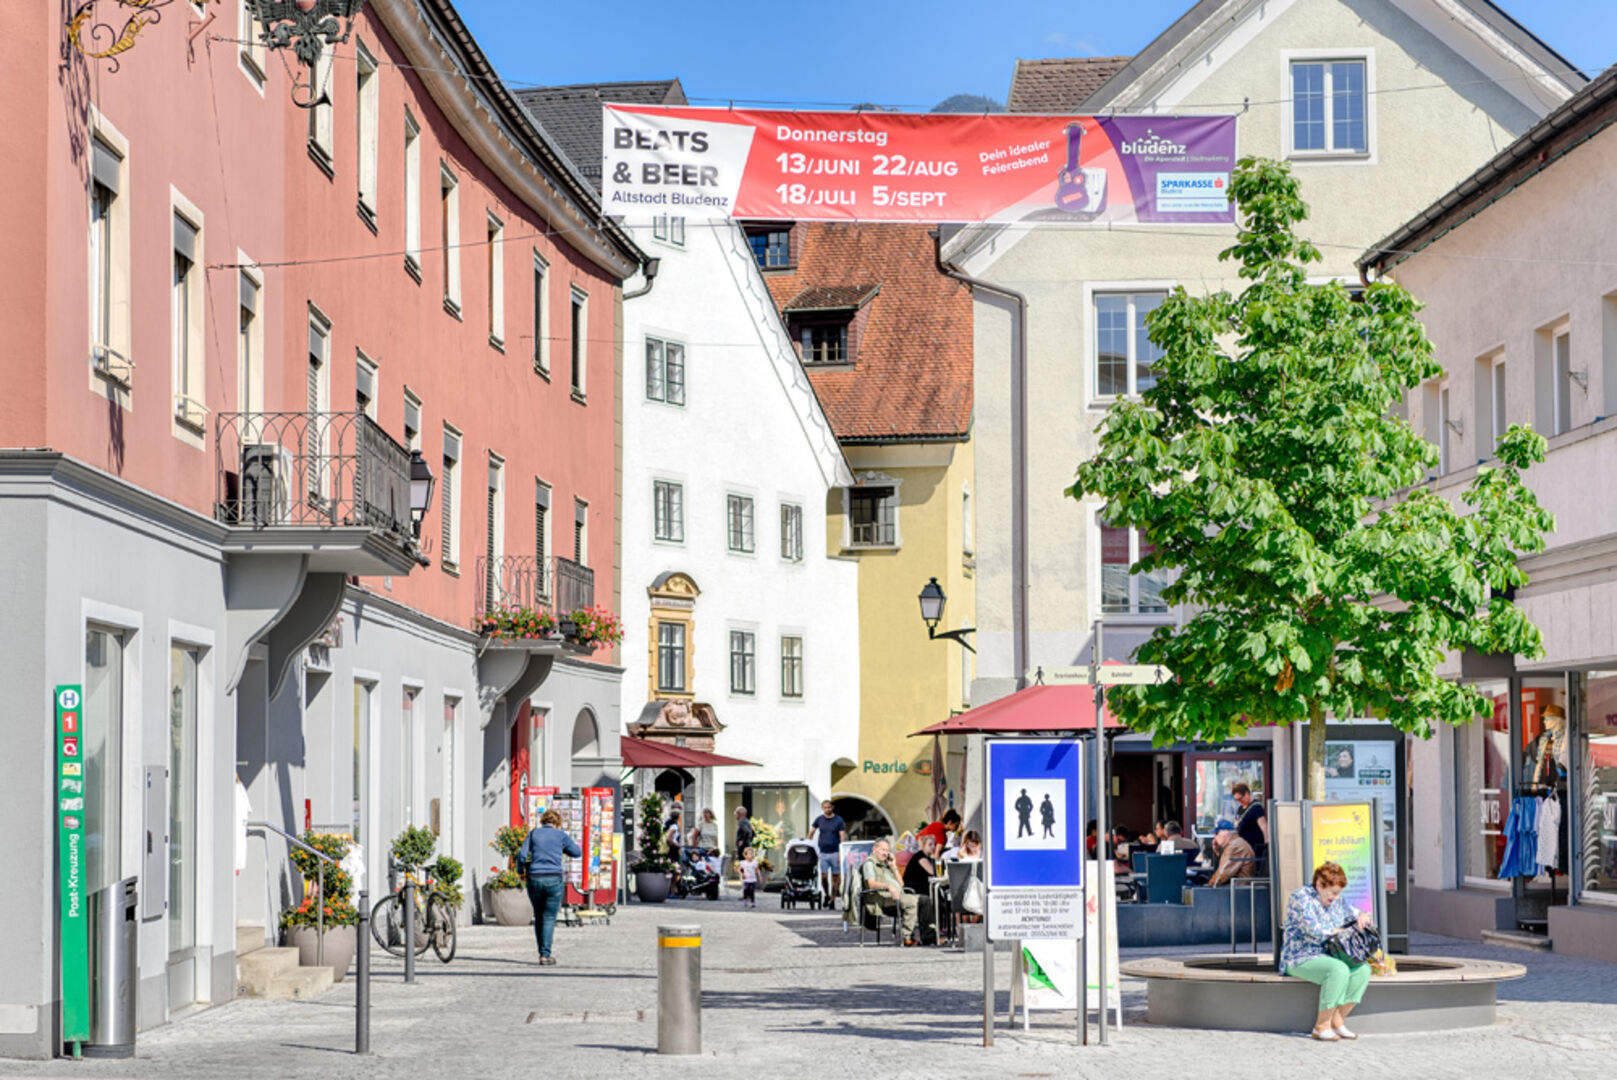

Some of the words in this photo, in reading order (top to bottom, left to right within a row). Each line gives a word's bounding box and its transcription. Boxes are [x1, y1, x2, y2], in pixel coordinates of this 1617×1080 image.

[613, 127, 709, 153] BEATS
[777, 125, 888, 147] Donnerstag
[979, 148, 1007, 163] Dein
[1009, 140, 1051, 157] idealer
[1121, 141, 1187, 155] bludenz
[612, 161, 632, 184] &
[641, 162, 719, 187] BEER
[776, 152, 860, 175] 13/JUNI
[872, 154, 959, 177] 22/AUG
[982, 153, 1049, 176] Feierabend
[776, 183, 856, 205] 18/JULI
[872, 185, 948, 207] 5/SEPT
[1161, 180, 1213, 189] SPARKASSE
[612, 191, 667, 205] Altstadt
[671, 192, 729, 207] Bludenz
[63, 692, 75, 706] H
[65, 714, 73, 729] 1
[863, 760, 908, 774] Pearle
[69, 833, 80, 918] Post-Kreuzung
